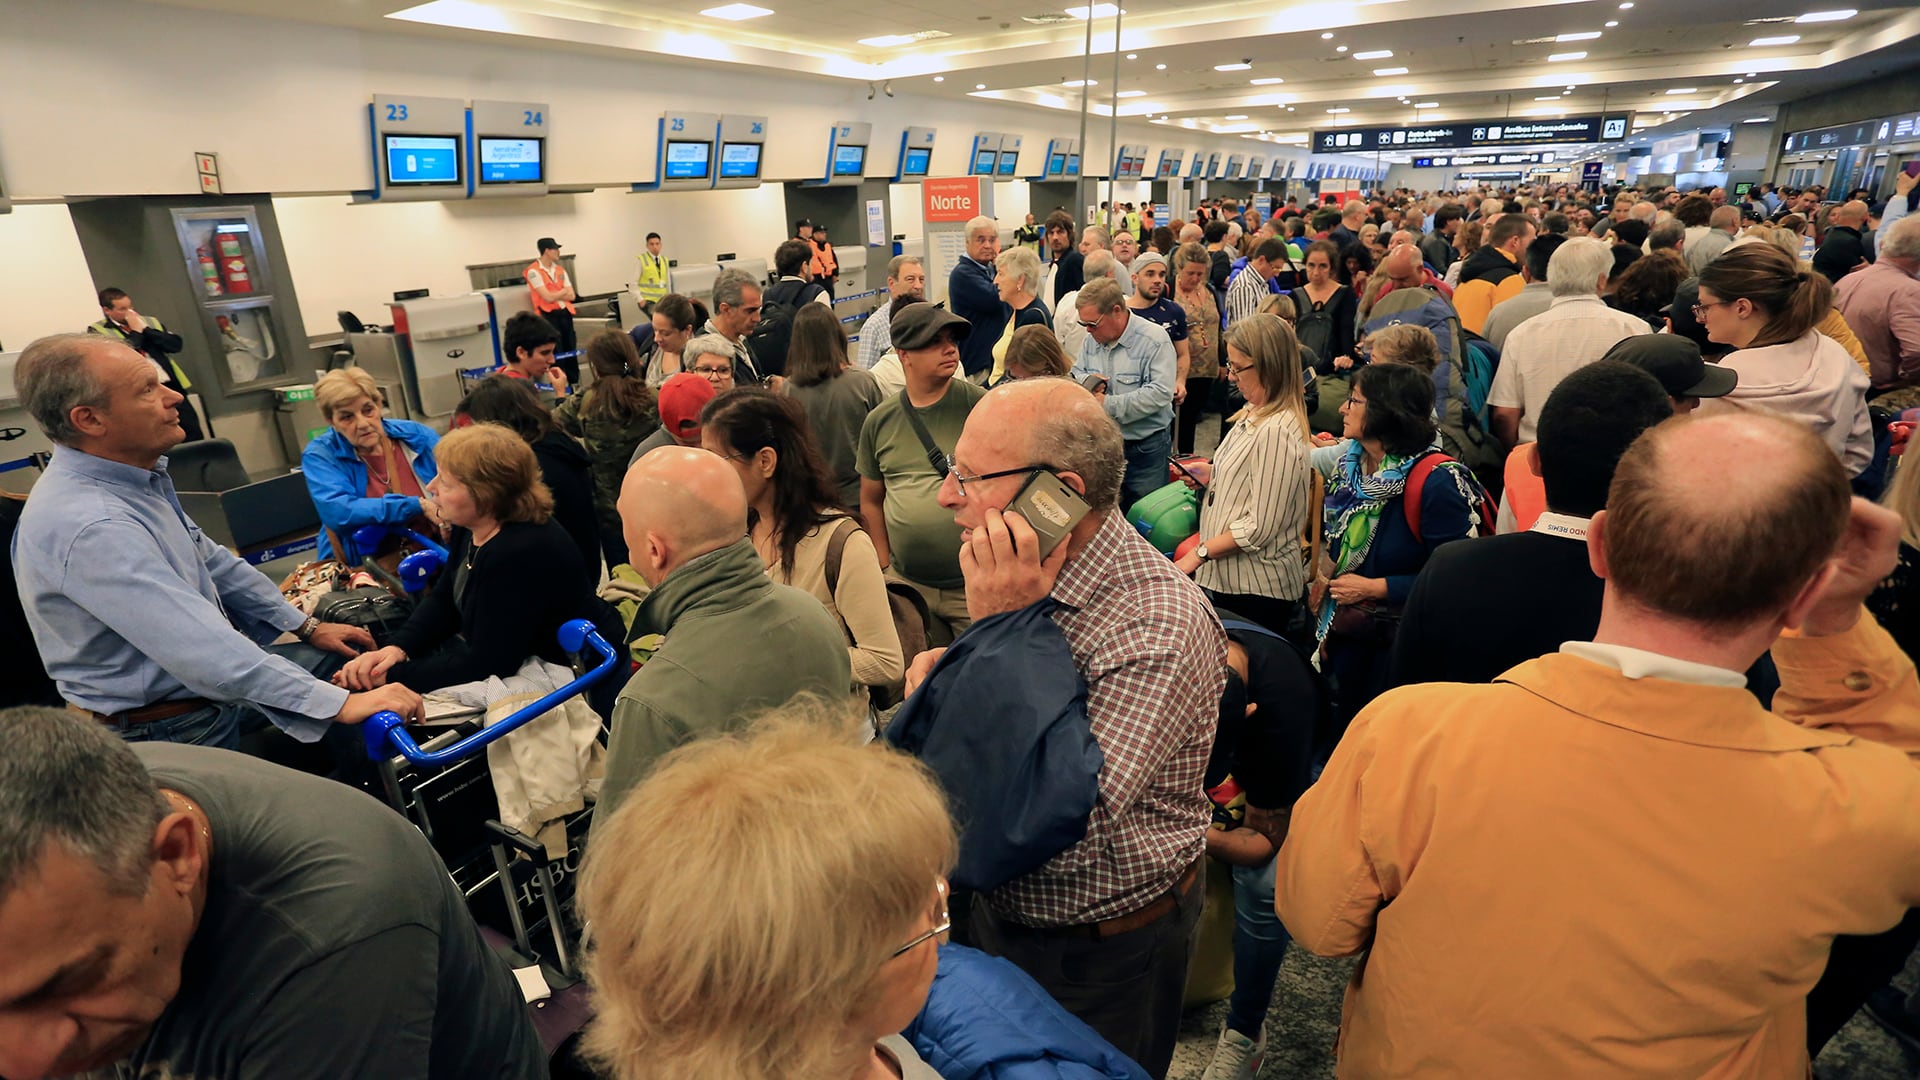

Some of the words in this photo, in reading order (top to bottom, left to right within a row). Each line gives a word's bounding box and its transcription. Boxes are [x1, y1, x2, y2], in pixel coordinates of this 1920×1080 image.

[386, 104, 408, 121] 23
[523, 111, 542, 126] 24
[671, 118, 684, 131] 25
[751, 122, 762, 134] 26
[1504, 125, 1530, 134] Arribos
[1407, 130, 1424, 138] Auto
[1425, 129, 1453, 137] check-in
[930, 195, 971, 210] Norte
[1547, 523, 1568, 534] REMIS
[517, 846, 580, 906] HSBC
